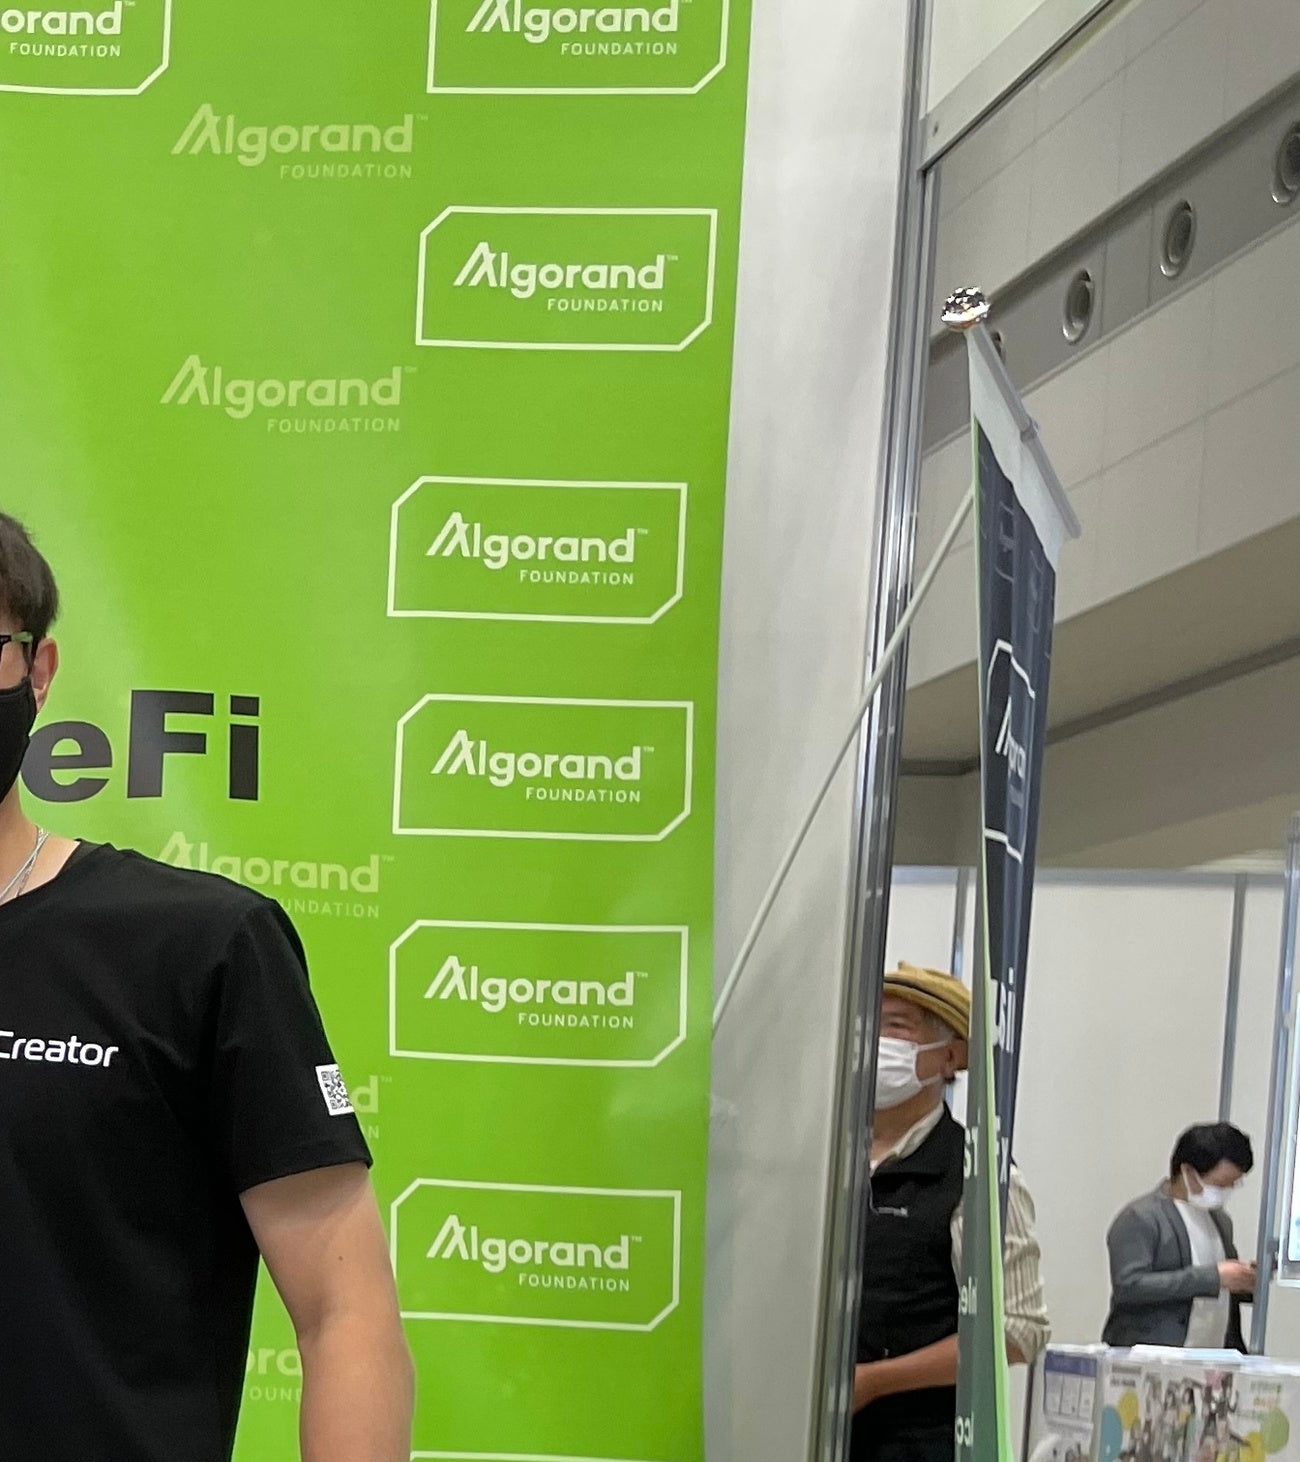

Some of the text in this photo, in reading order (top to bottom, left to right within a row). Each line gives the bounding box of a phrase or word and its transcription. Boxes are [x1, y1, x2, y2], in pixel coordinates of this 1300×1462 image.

[10, 43, 121, 57] FOUNDATION
[561, 43, 677, 56] FOUNDATION
[280, 164, 412, 179] FOUNDATION
[547, 298, 663, 312] FOUNDATION
[267, 417, 400, 433] FOUNDATION
[519, 570, 634, 585] FOUNDATION
[20, 690, 260, 803] eFi
[525, 786, 641, 803] FOUNDATION
[280, 899, 380, 919] UNDATION
[518, 1012, 634, 1029] FOUNDATION
[518, 1273, 630, 1291] FOUNDATION
